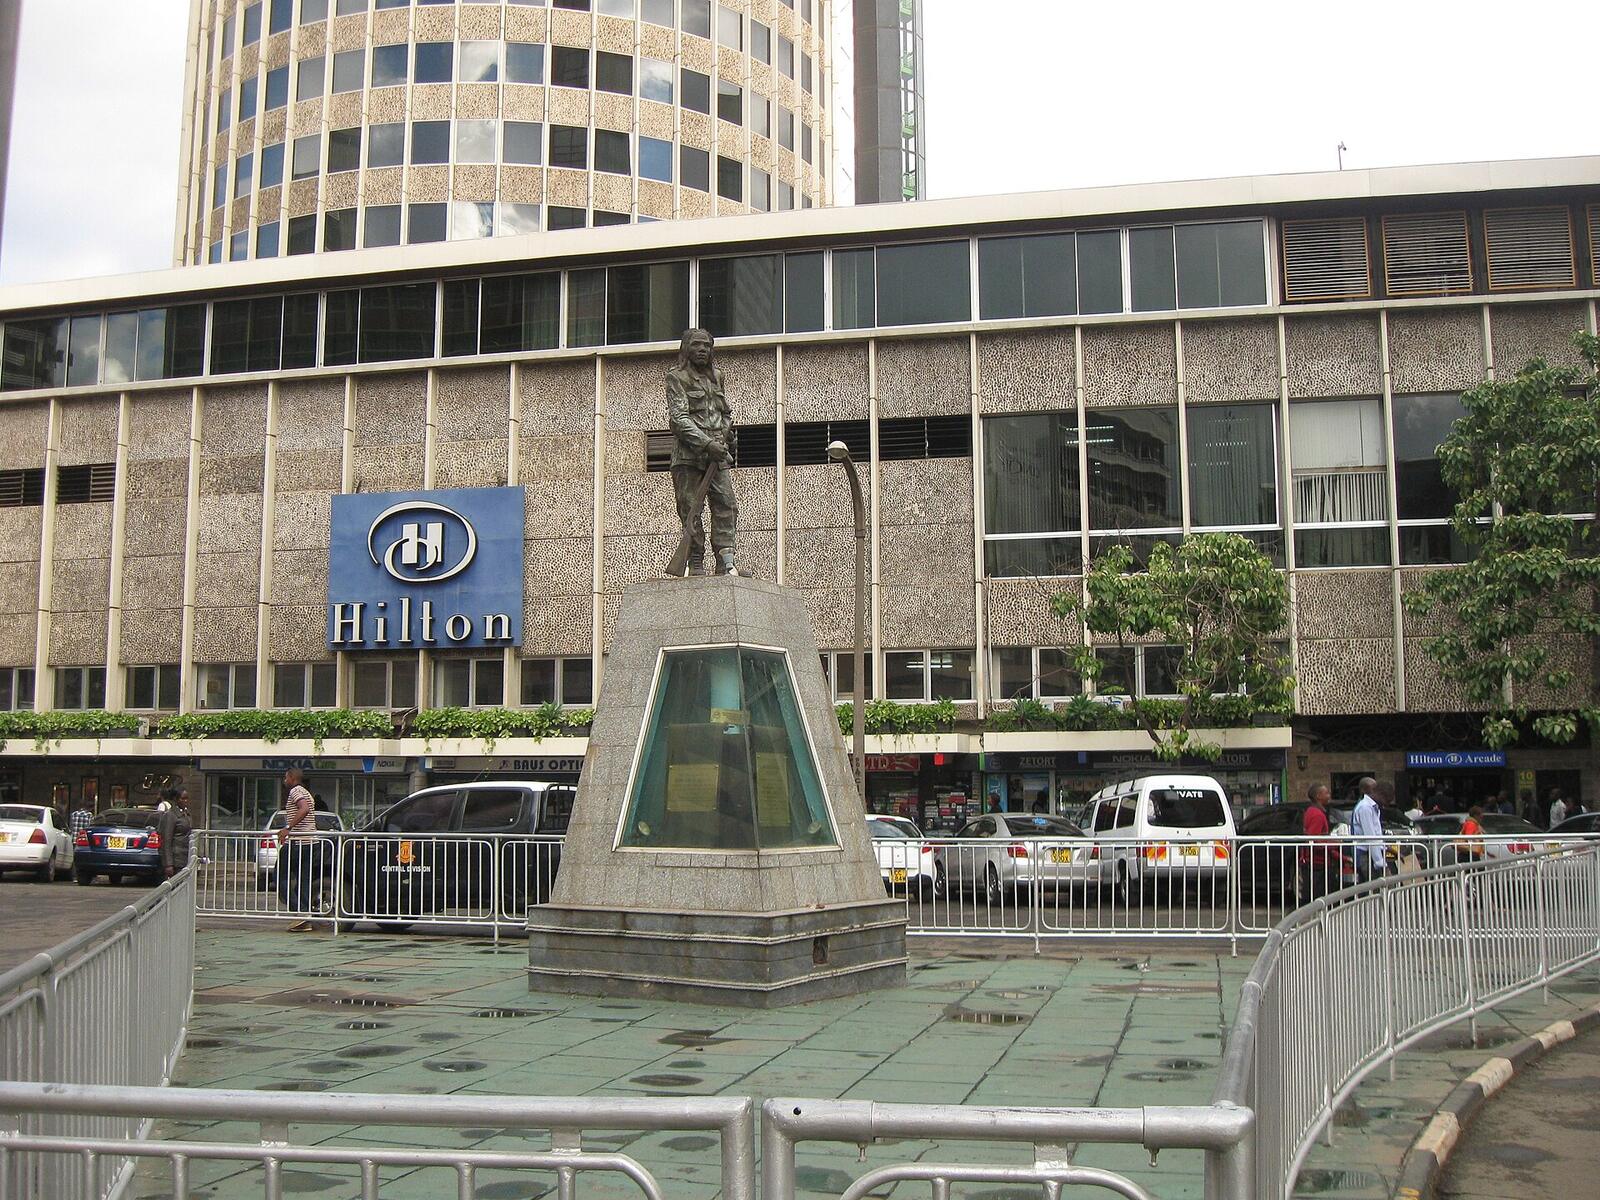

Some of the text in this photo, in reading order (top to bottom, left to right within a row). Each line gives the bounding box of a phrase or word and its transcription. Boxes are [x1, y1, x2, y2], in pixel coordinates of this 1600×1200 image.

[330, 597, 512, 643] Hilton
[262, 759, 314, 769] NOKIA
[1112, 755, 1152, 763] NOKIA
[1410, 754, 1502, 764] Hilton Arcade
[513, 759, 544, 770] BAUS
[381, 865, 431, 873] CENTRAL DVISON
